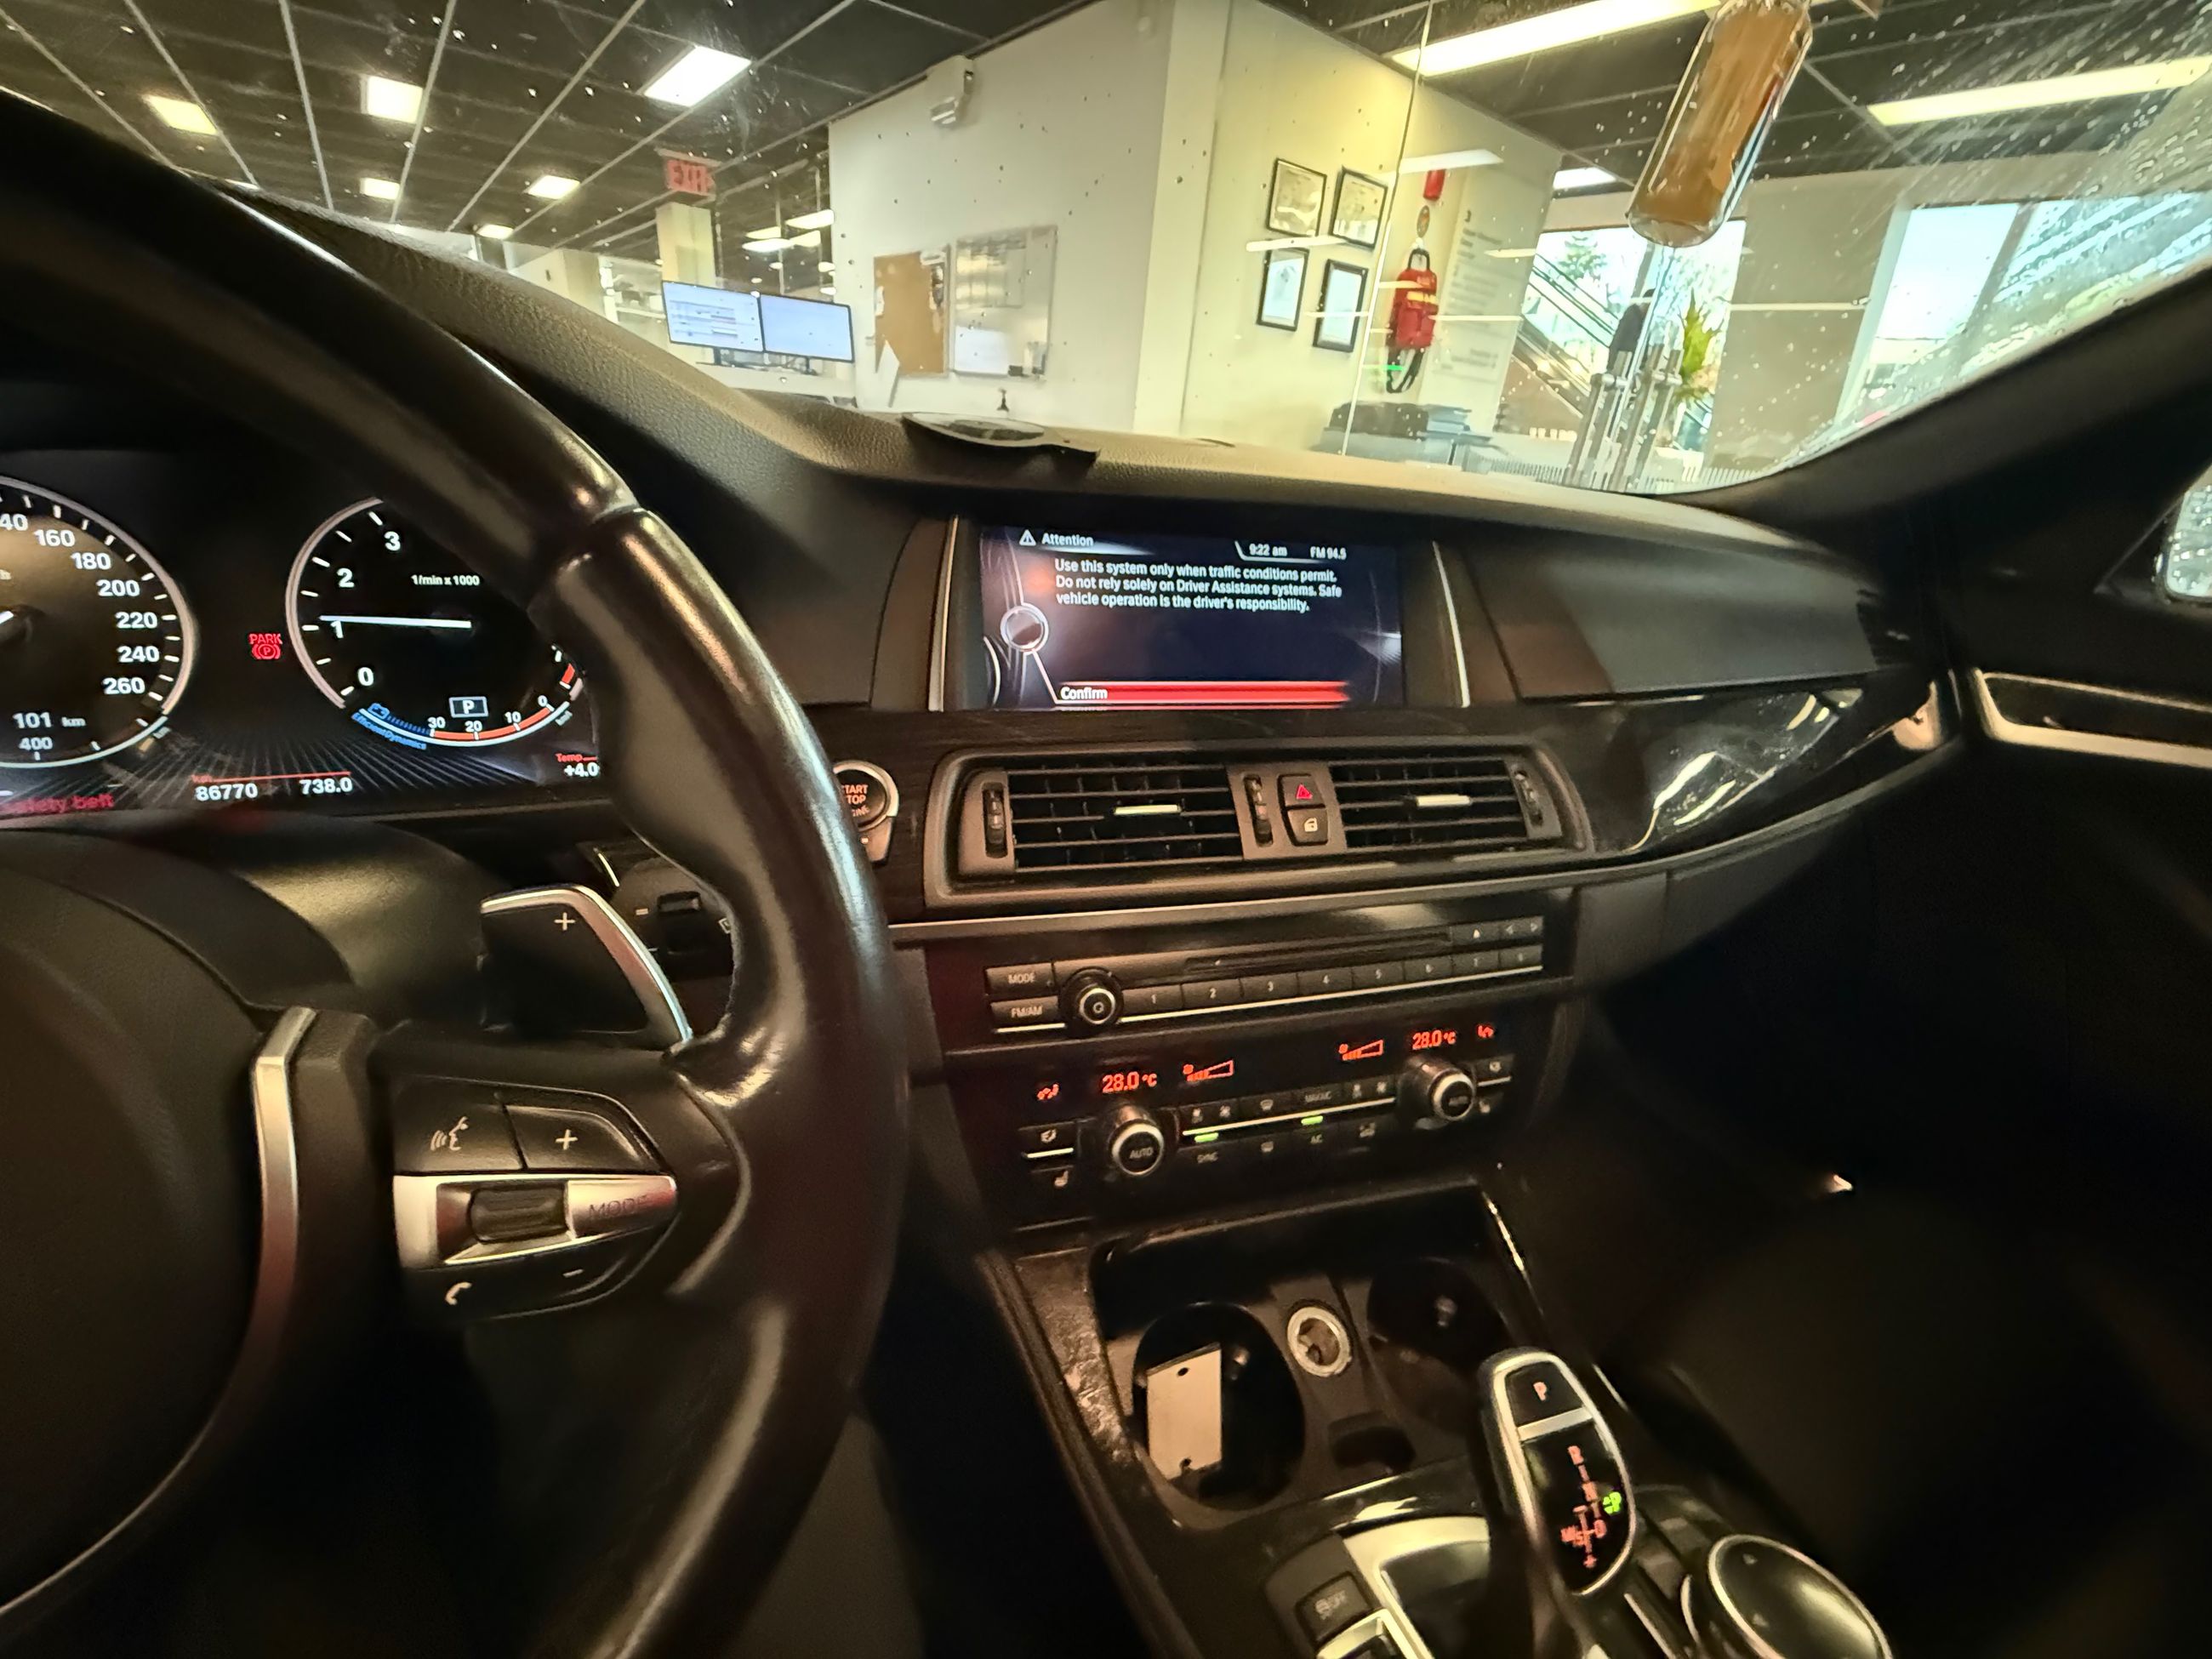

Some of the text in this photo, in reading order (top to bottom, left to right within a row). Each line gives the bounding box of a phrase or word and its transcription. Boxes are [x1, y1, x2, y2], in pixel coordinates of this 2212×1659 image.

[668, 159, 708, 195] EXIT
[0, 513, 28, 531] 40
[34, 529, 76, 547] 160
[385, 531, 401, 550] 3
[1041, 533, 1094, 546] Attention
[1249, 544, 1270, 556] 9:22
[1272, 546, 1287, 556] am
[1310, 546, 1325, 559] FM
[71, 552, 112, 571] 180
[337, 568, 355, 588] 2
[411, 574, 443, 586] 1/min
[453, 574, 480, 586] 1000
[1055, 558, 1337, 584] Use this system only when traffic conditions permit.
[96, 579, 140, 597] 200
[1055, 574, 1343, 598] Do not rely solely on Driver Assistance systems. Safe
[1056, 592, 1310, 613] vehicle operation is the driver's responsibility.
[115, 612, 157, 630] 220
[330, 620, 344, 638] 1
[249, 633, 282, 644] PARK
[117, 647, 160, 664] 240
[358, 667, 374, 687] 0
[102, 678, 145, 695] 260
[1060, 687, 1108, 701] Confirm
[462, 699, 476, 714] P
[538, 695, 548, 707] 0
[13, 712, 86, 729] 101 km
[428, 716, 445, 729] 30
[505, 711, 522, 723] 10
[465, 721, 482, 732] 20
[19, 737, 53, 750] 400
[564, 762, 600, 777] +4.0
[195, 783, 258, 801] 86770
[299, 778, 352, 795] 738.0
[847, 795, 866, 805] TOP
[1209, 987, 1217, 999] 2
[1268, 981, 1274, 993] 3
[1322, 974, 1330, 985] 4
[1412, 1030, 1442, 1051] 28.0
[1102, 1070, 1139, 1093] 28.0
[589, 1194, 647, 1221] MODE
[1534, 1381, 1548, 1401] P
